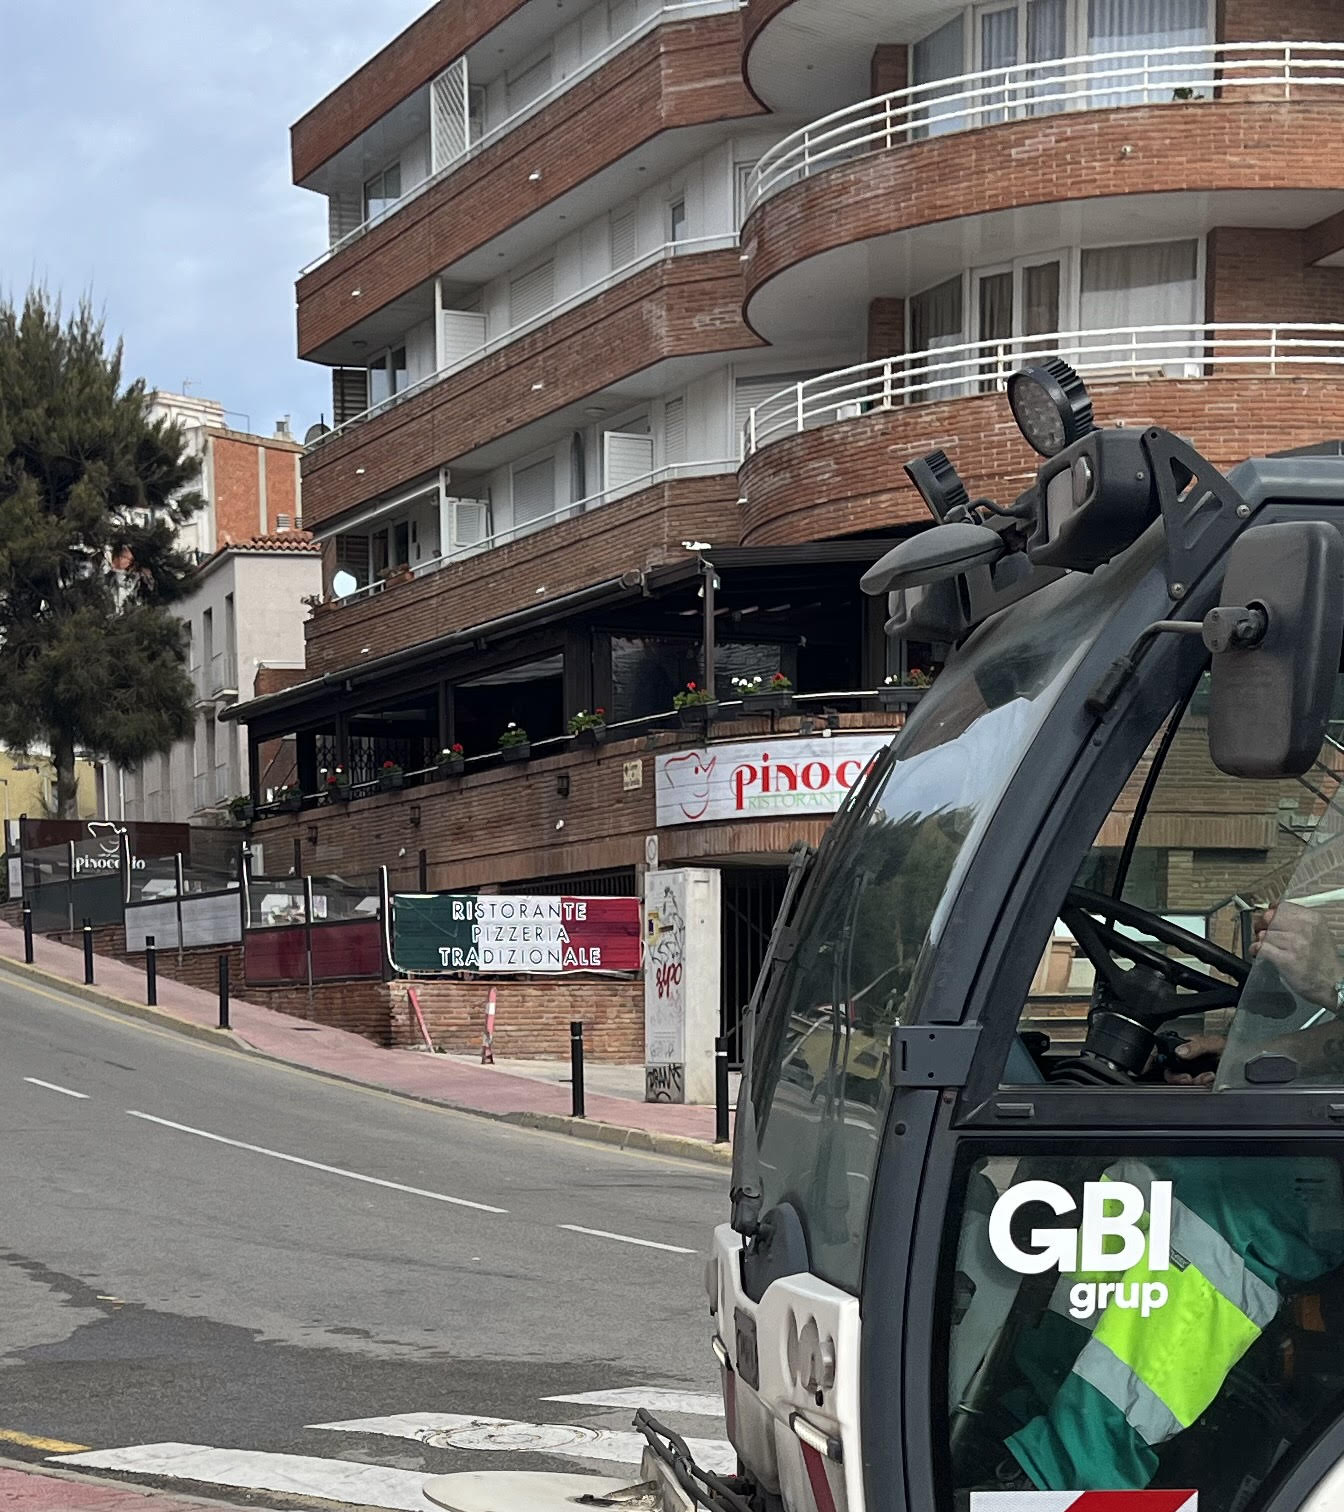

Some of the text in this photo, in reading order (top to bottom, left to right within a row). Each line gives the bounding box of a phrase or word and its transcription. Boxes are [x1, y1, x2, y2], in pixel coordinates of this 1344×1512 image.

[748, 790, 846, 810] RISTORANT
[452, 901, 587, 921] RISTORANTE
[472, 924, 570, 944] PIZZERIA
[439, 947, 602, 966] TRADIZIONALE
[989, 1180, 1172, 1275] GBI
[1069, 1282, 1169, 1319] grup
